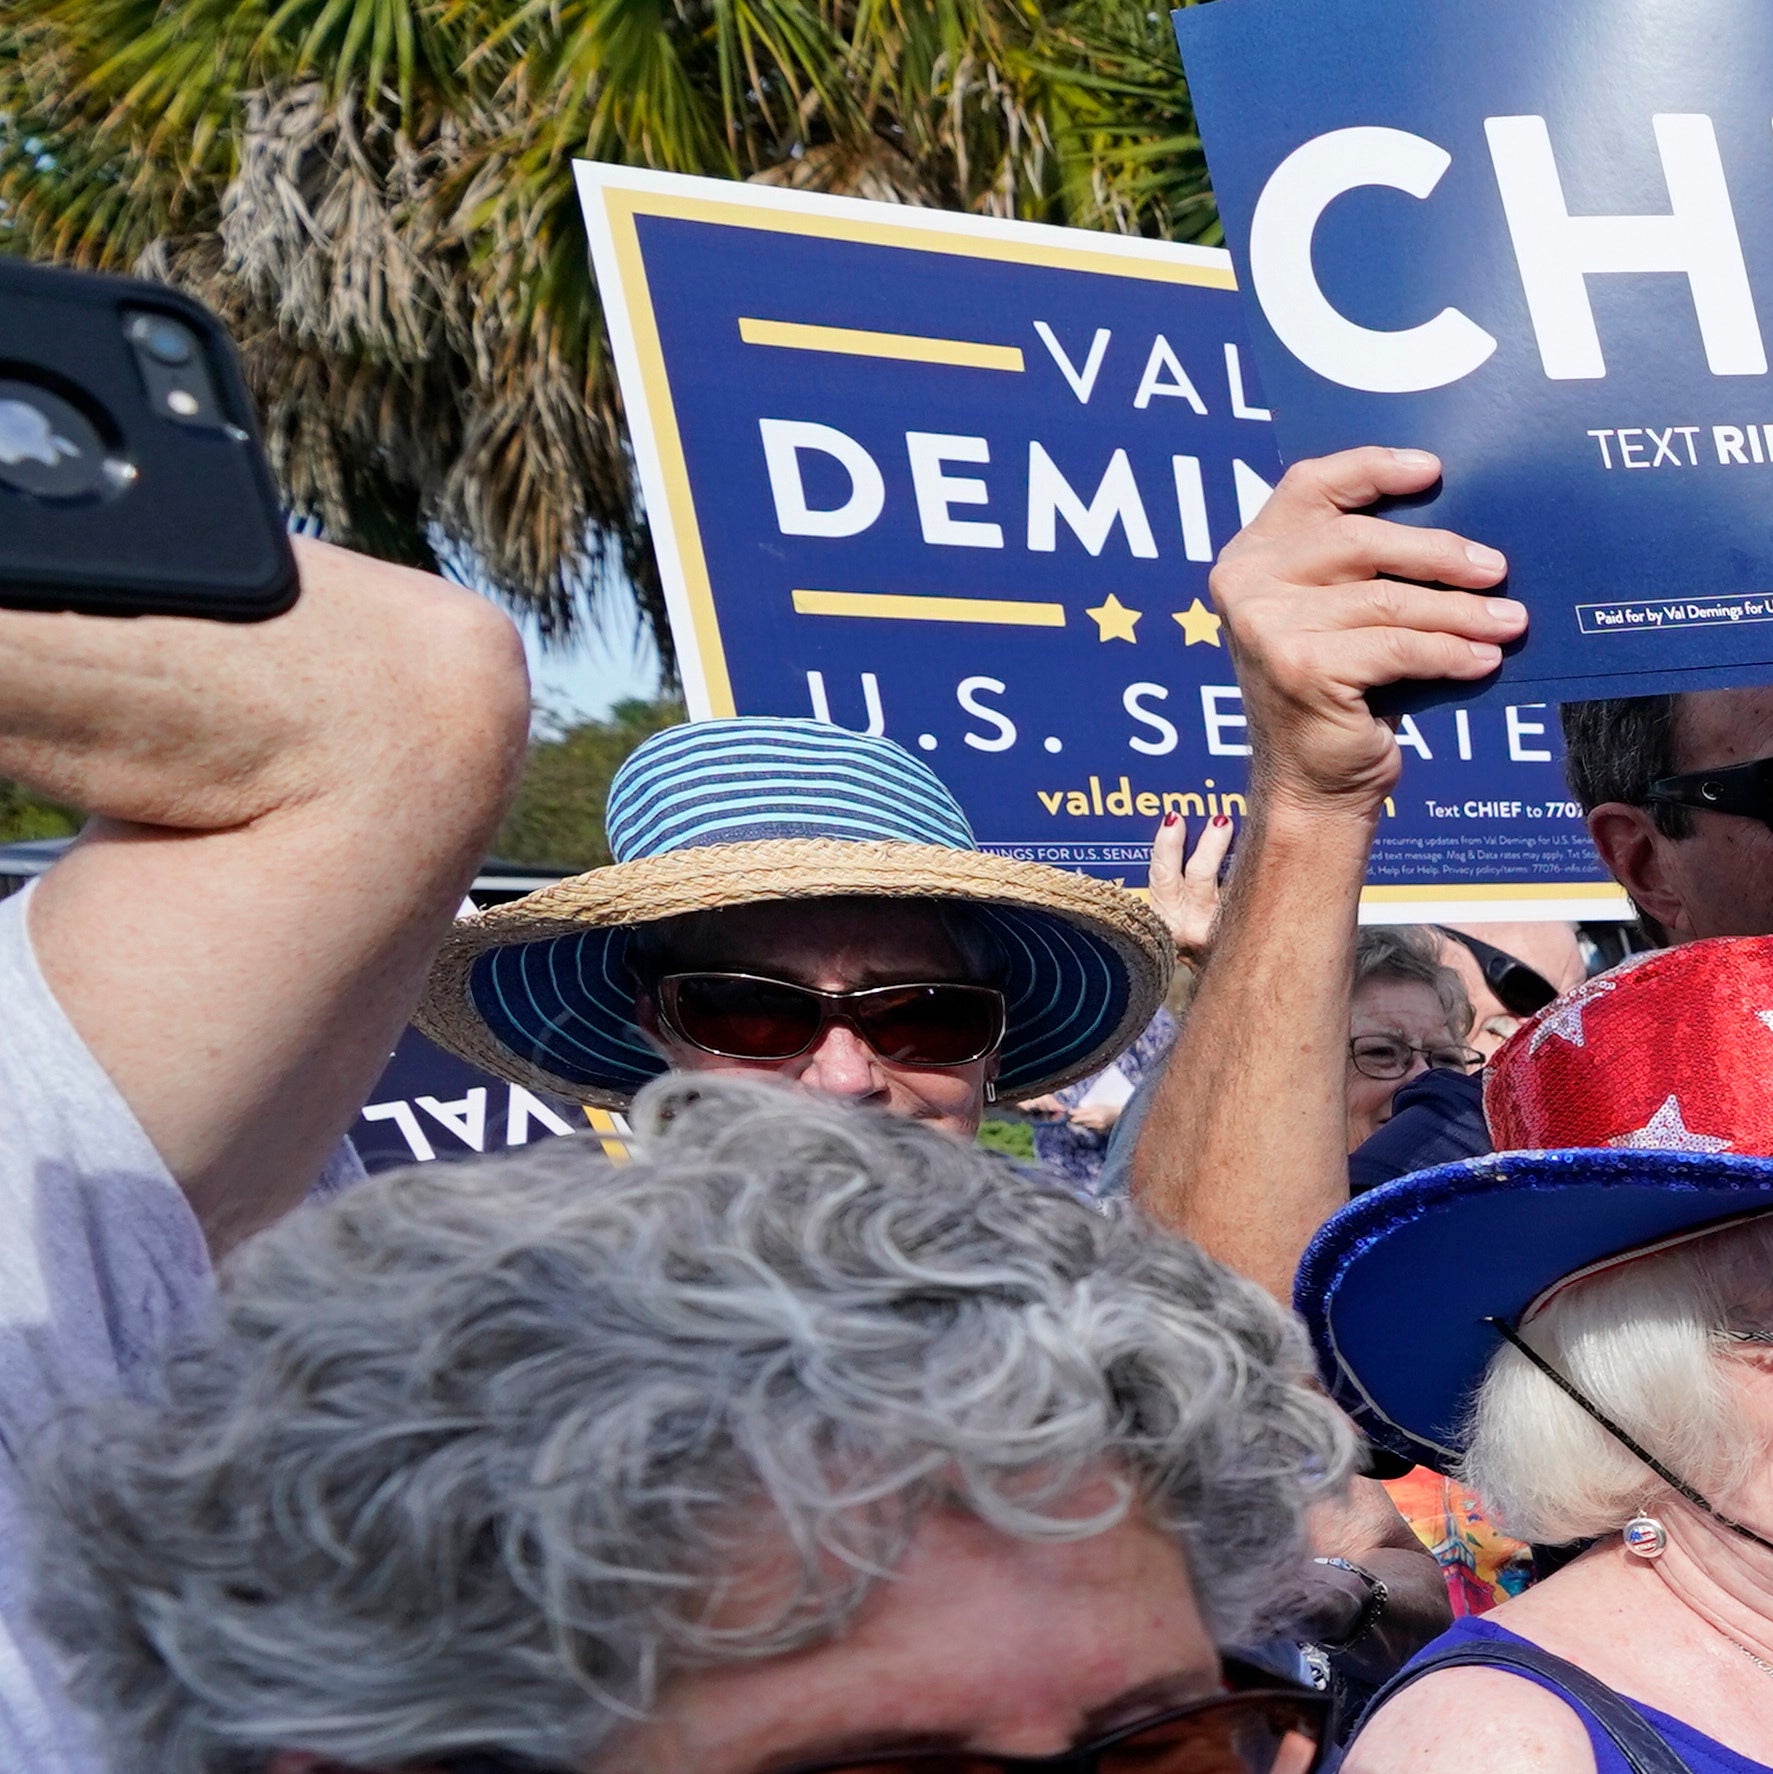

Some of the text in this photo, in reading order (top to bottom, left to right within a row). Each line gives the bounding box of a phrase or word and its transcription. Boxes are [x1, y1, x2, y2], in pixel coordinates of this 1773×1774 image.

[1033, 320, 1272, 421] VAL
[1587, 427, 1701, 469] TEXT
[1595, 610, 1623, 626] Paid
[1625, 609, 1644, 624] for
[1646, 608, 1663, 626] by
[1664, 605, 1685, 621] Val
[1688, 601, 1743, 622] Demings
[1744, 600, 1763, 615] for
[806, 670, 1063, 755] U.S.
[1426, 801, 1459, 818] Text
[1464, 801, 1522, 818] CHIEF
[1526, 804, 1542, 818] to
[1037, 848, 1071, 861] FOR
[1077, 848, 1100, 861] U.S.
[361, 1082, 576, 1162] VAL
